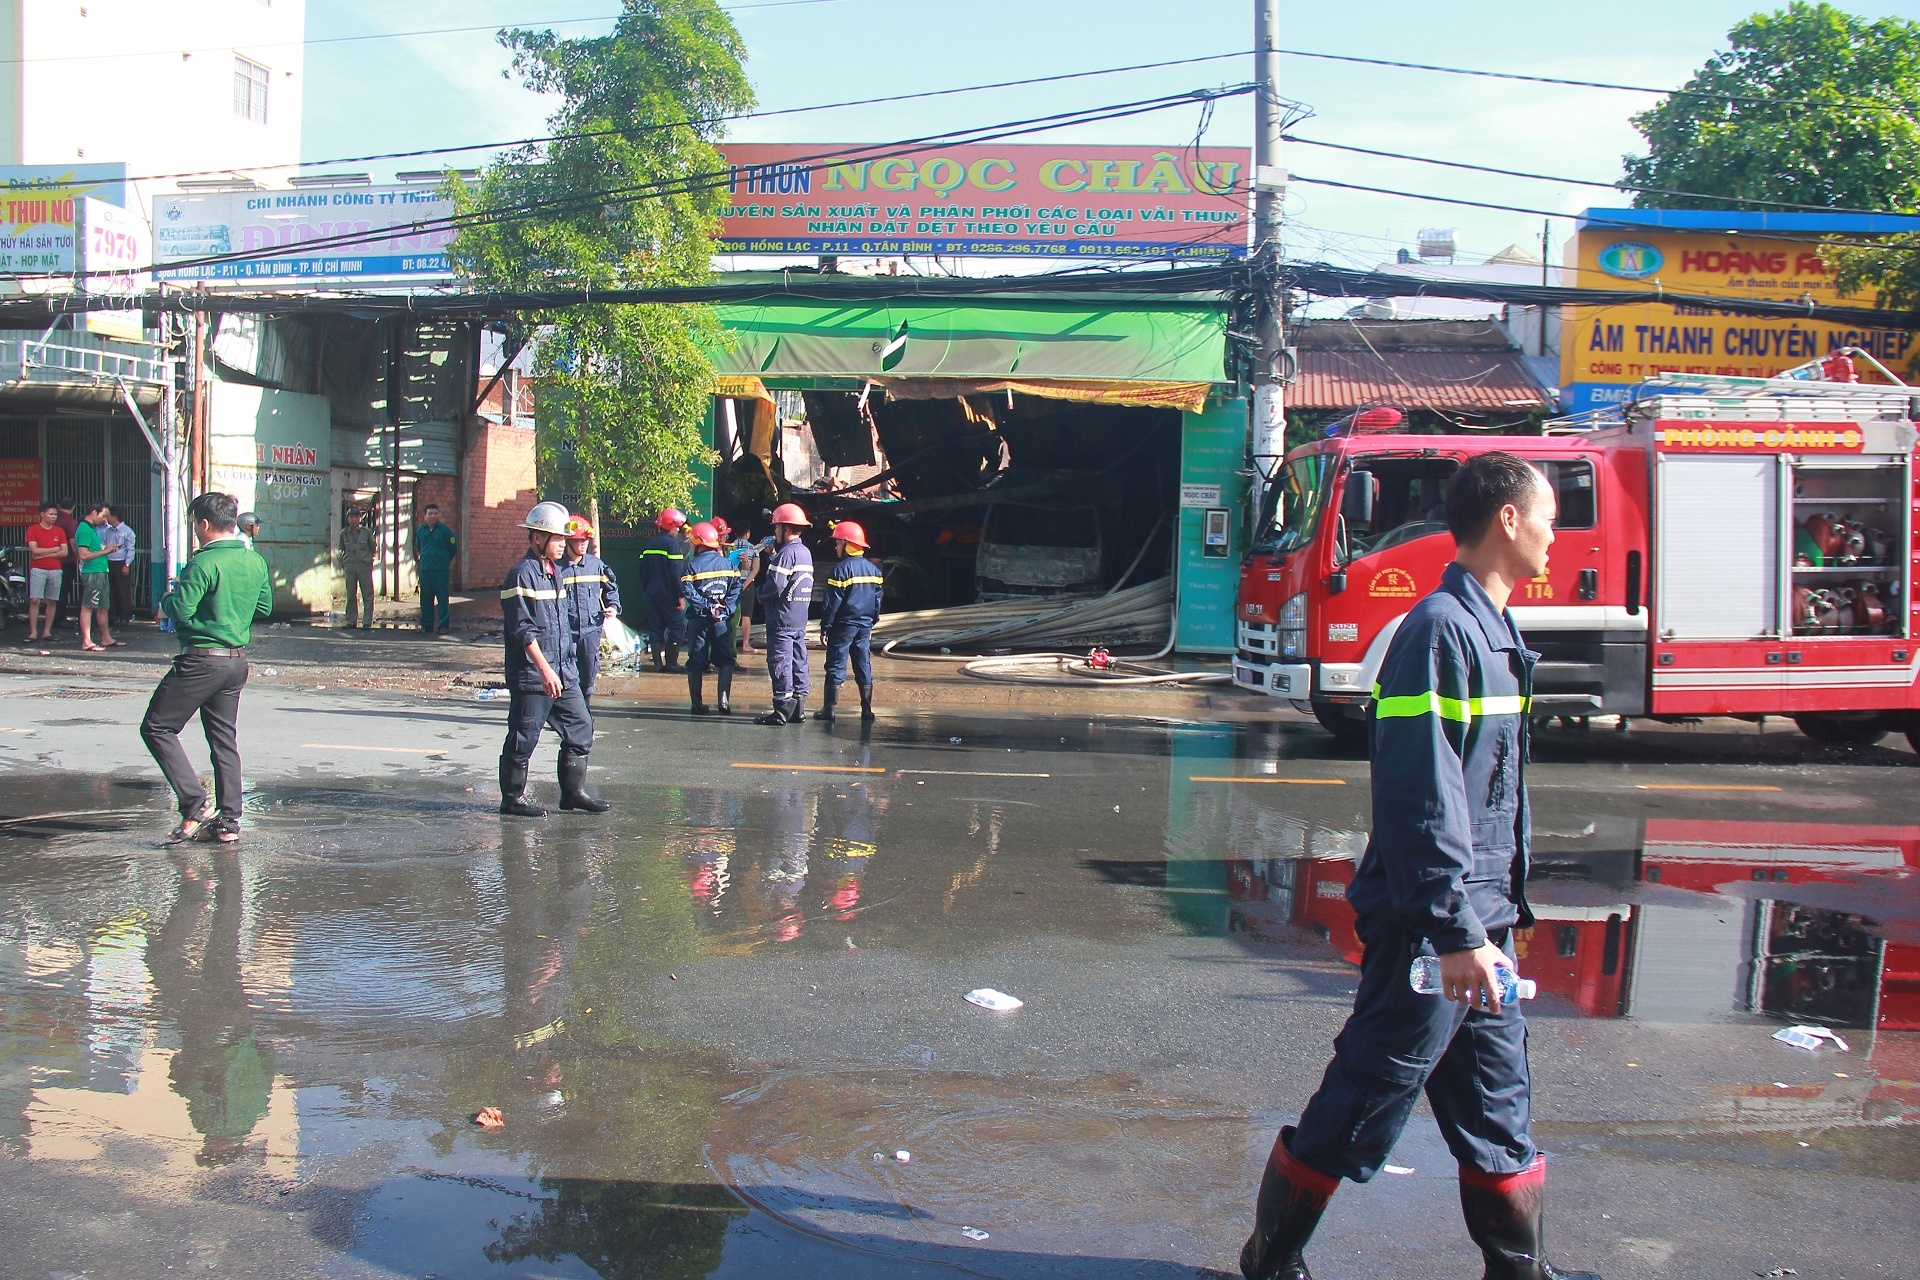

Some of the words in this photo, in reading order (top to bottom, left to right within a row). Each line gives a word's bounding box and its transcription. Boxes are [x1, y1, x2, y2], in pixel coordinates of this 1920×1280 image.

[744, 163, 812, 195] THUN
[821, 157, 1018, 199] NGỌC
[1037, 151, 1242, 197] CHÂU
[247, 197, 271, 211] CHI
[276, 193, 328, 208] NHÁNH
[333, 191, 374, 206] CÔNG
[7, 200, 48, 224] THUI
[714, 203, 775, 218] HUYÊN
[780, 202, 821, 218] SẢN
[826, 202, 880, 219] XUẤT
[885, 203, 912, 219] VÀ
[919, 204, 975, 219] PHÂN
[981, 203, 1031, 219] PHỐI
[1037, 205, 1079, 220] CÁC
[1085, 208, 1133, 223] LOẠI
[1139, 206, 1175, 221] VẢI
[1180, 209, 1239, 223] THUN
[240, 218, 372, 254] ĐÌNH
[807, 219, 863, 235] NHẬN
[869, 219, 911, 236] ĐẶT
[916, 219, 957, 236] DỆT
[963, 221, 1019, 235] THEO
[1025, 221, 1067, 236] YÊU
[1073, 220, 1116, 236] CẦU
[20, 233, 34, 249] HẢI
[36, 233, 52, 249] SẢN
[93, 226, 137, 262] 7979
[750, 239, 784, 252] HỒNG
[786, 241, 811, 253] LẠC
[822, 242, 849, 252] P.11
[902, 240, 933, 252] BÌNH
[222, 264, 238, 276] P.11
[256, 262, 272, 274] TÂN
[272, 261, 293, 274] BÌNH
[299, 262, 311, 273] TP.
[325, 259, 339, 272] CHÍ
[340, 260, 363, 272] MINH
[1681, 242, 1788, 275] HOÀNG
[1589, 318, 1624, 353] ÂM
[1635, 324, 1714, 355] THANH
[1724, 322, 1818, 358] CHUYÊN
[1589, 360, 1623, 376] CÔNG
[1627, 363, 1644, 376] TY
[1664, 424, 1756, 448] PHÒNG
[1762, 423, 1836, 448] CẢNH
[272, 442, 318, 467] NHÂN
[273, 484, 309, 500] 306A
[1524, 584, 1554, 599] 114
